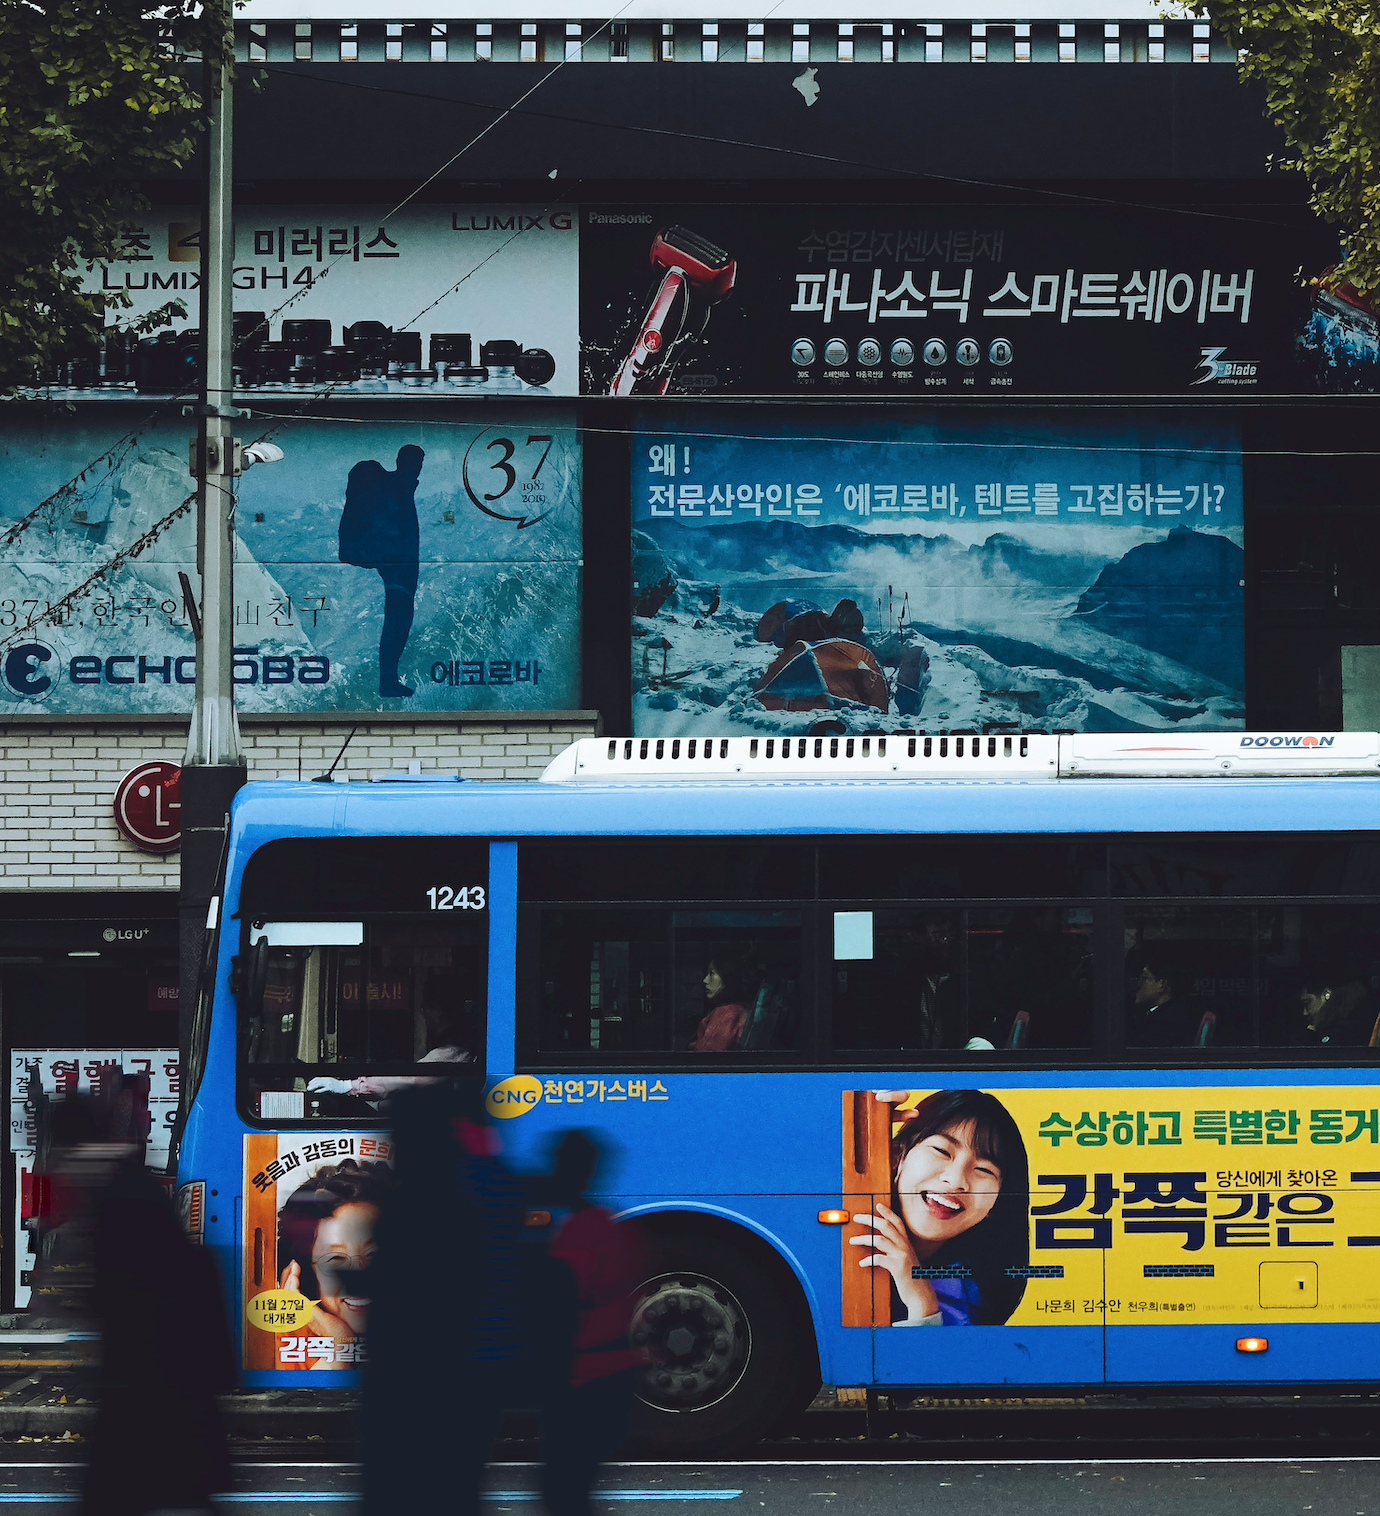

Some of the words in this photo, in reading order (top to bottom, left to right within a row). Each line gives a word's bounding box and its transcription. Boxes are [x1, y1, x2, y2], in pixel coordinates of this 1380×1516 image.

[452, 212, 545, 231] LUMIX
[588, 211, 653, 225] Panasonic
[254, 225, 400, 262] 미러리스
[798, 228, 1004, 264] 수염감지센서탑재
[232, 266, 316, 291] GH4
[790, 267, 974, 324] 파나소닉
[982, 267, 1256, 324] 스마트쉐이버
[484, 434, 554, 501] 37
[647, 443, 692, 477] 왜!
[522, 494, 546, 505] 2019
[647, 482, 824, 518] 전문산악인은
[975, 482, 1061, 517] 텐트를
[1067, 482, 1226, 517] 고집하는가?
[92, 596, 204, 629] 한국인
[430, 659, 543, 688] 에코로바
[425, 886, 486, 911] 1243
[491, 1089, 538, 1105] CNG
[543, 1079, 670, 1103] 천연가스버스
[1037, 1110, 1182, 1148] 수상하고
[1193, 1109, 1301, 1146] 특별한
[251, 1150, 302, 1194] 웃음과
[301, 1138, 355, 1164] 감동의
[1216, 1169, 1283, 1189] 당신에게
[1287, 1168, 1339, 1188] 찾아온
[254, 1299, 278, 1311] 11월
[279, 1299, 305, 1311] 27일
[1035, 1299, 1076, 1314] 나문희
[1083, 1299, 1122, 1314] 김수안
[263, 1312, 297, 1325] 대개봉
